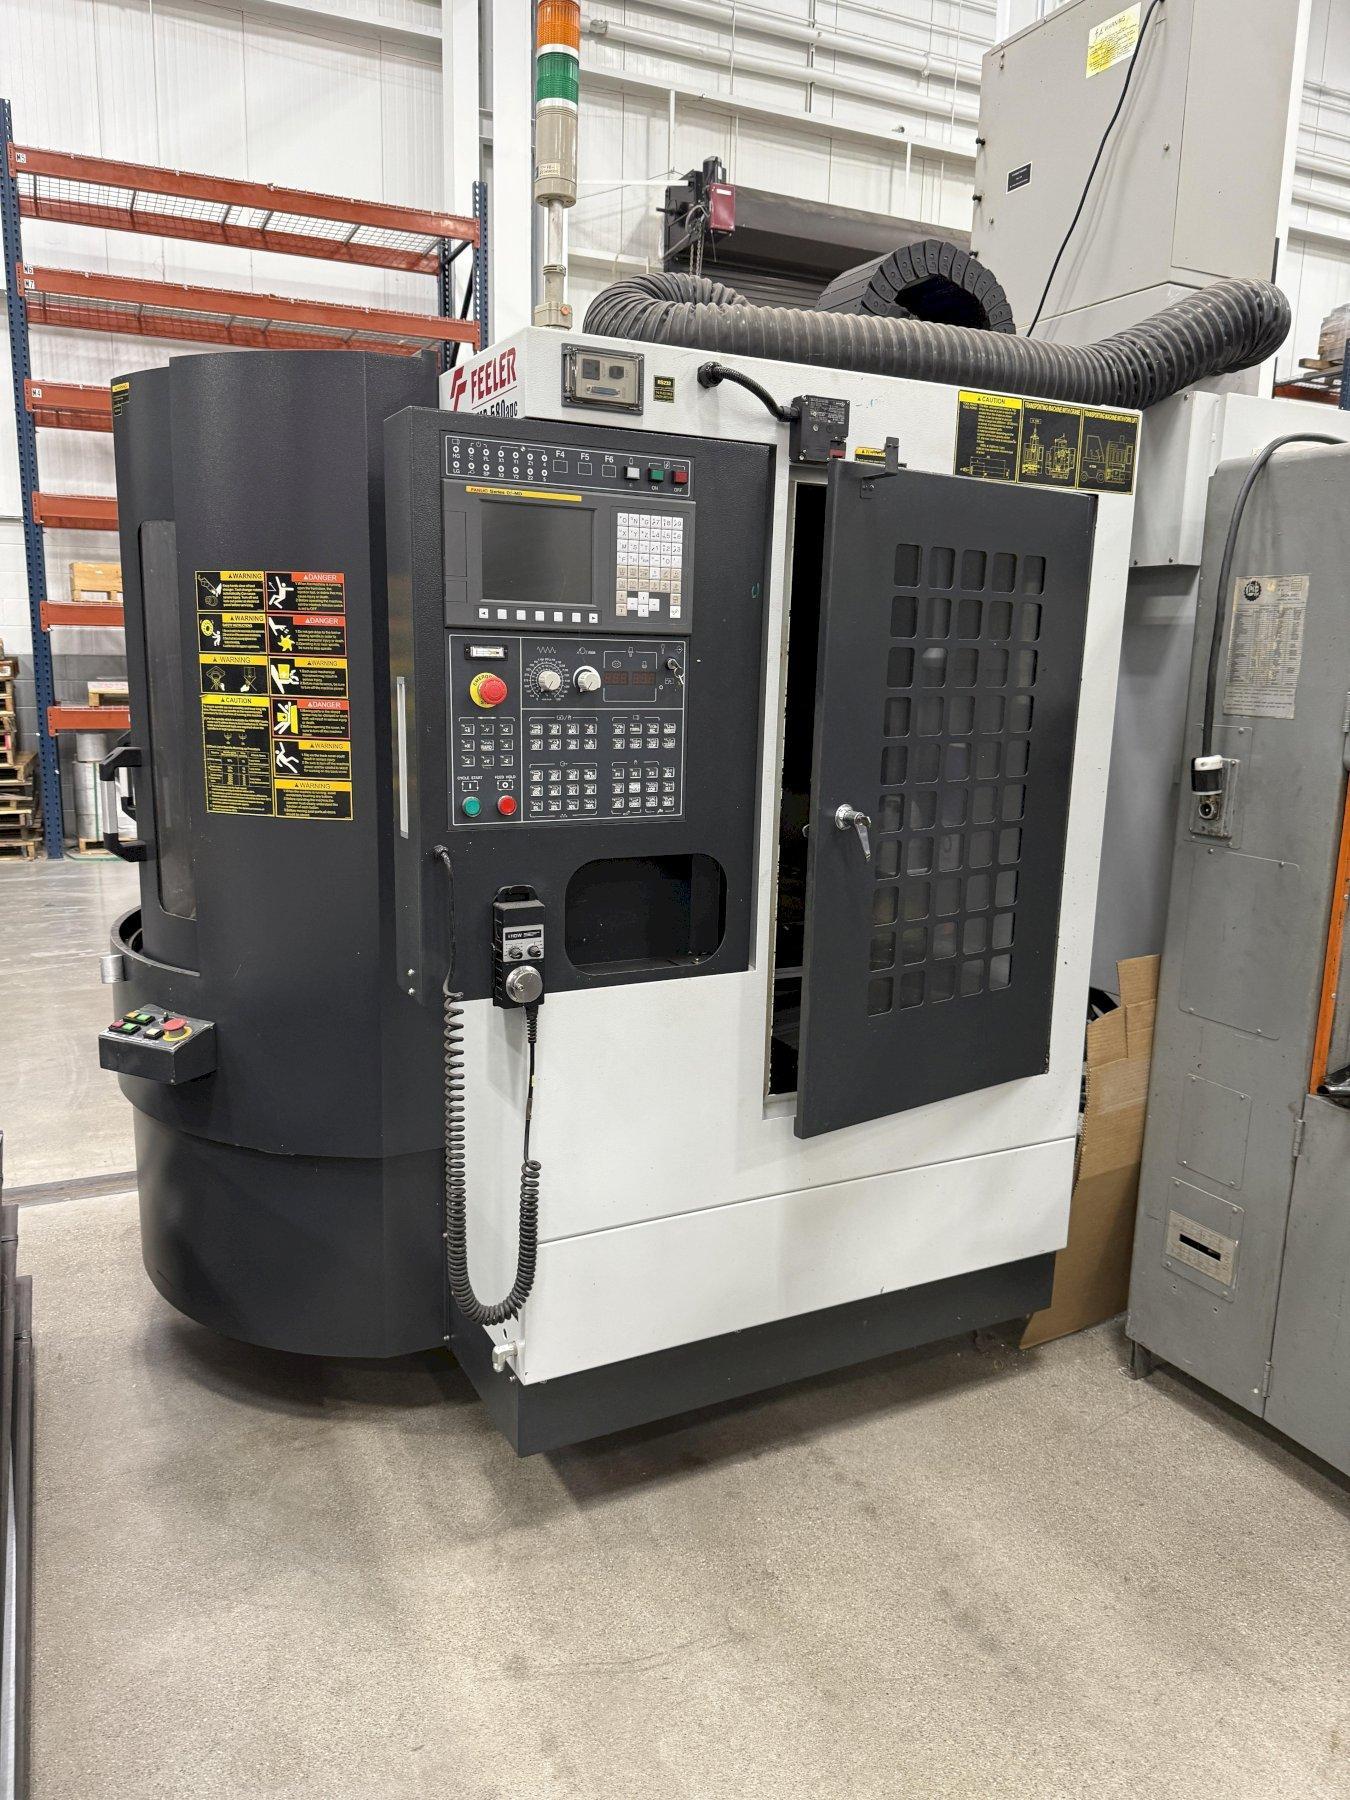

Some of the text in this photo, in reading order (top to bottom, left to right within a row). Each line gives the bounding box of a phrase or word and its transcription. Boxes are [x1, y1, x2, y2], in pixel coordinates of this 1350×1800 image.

[471, 347, 516, 403] FEELER
[982, 396, 1006, 404] CAUTION
[556, 450, 565, 458] F4
[580, 452, 590, 460] F5
[604, 455, 614, 463] F6
